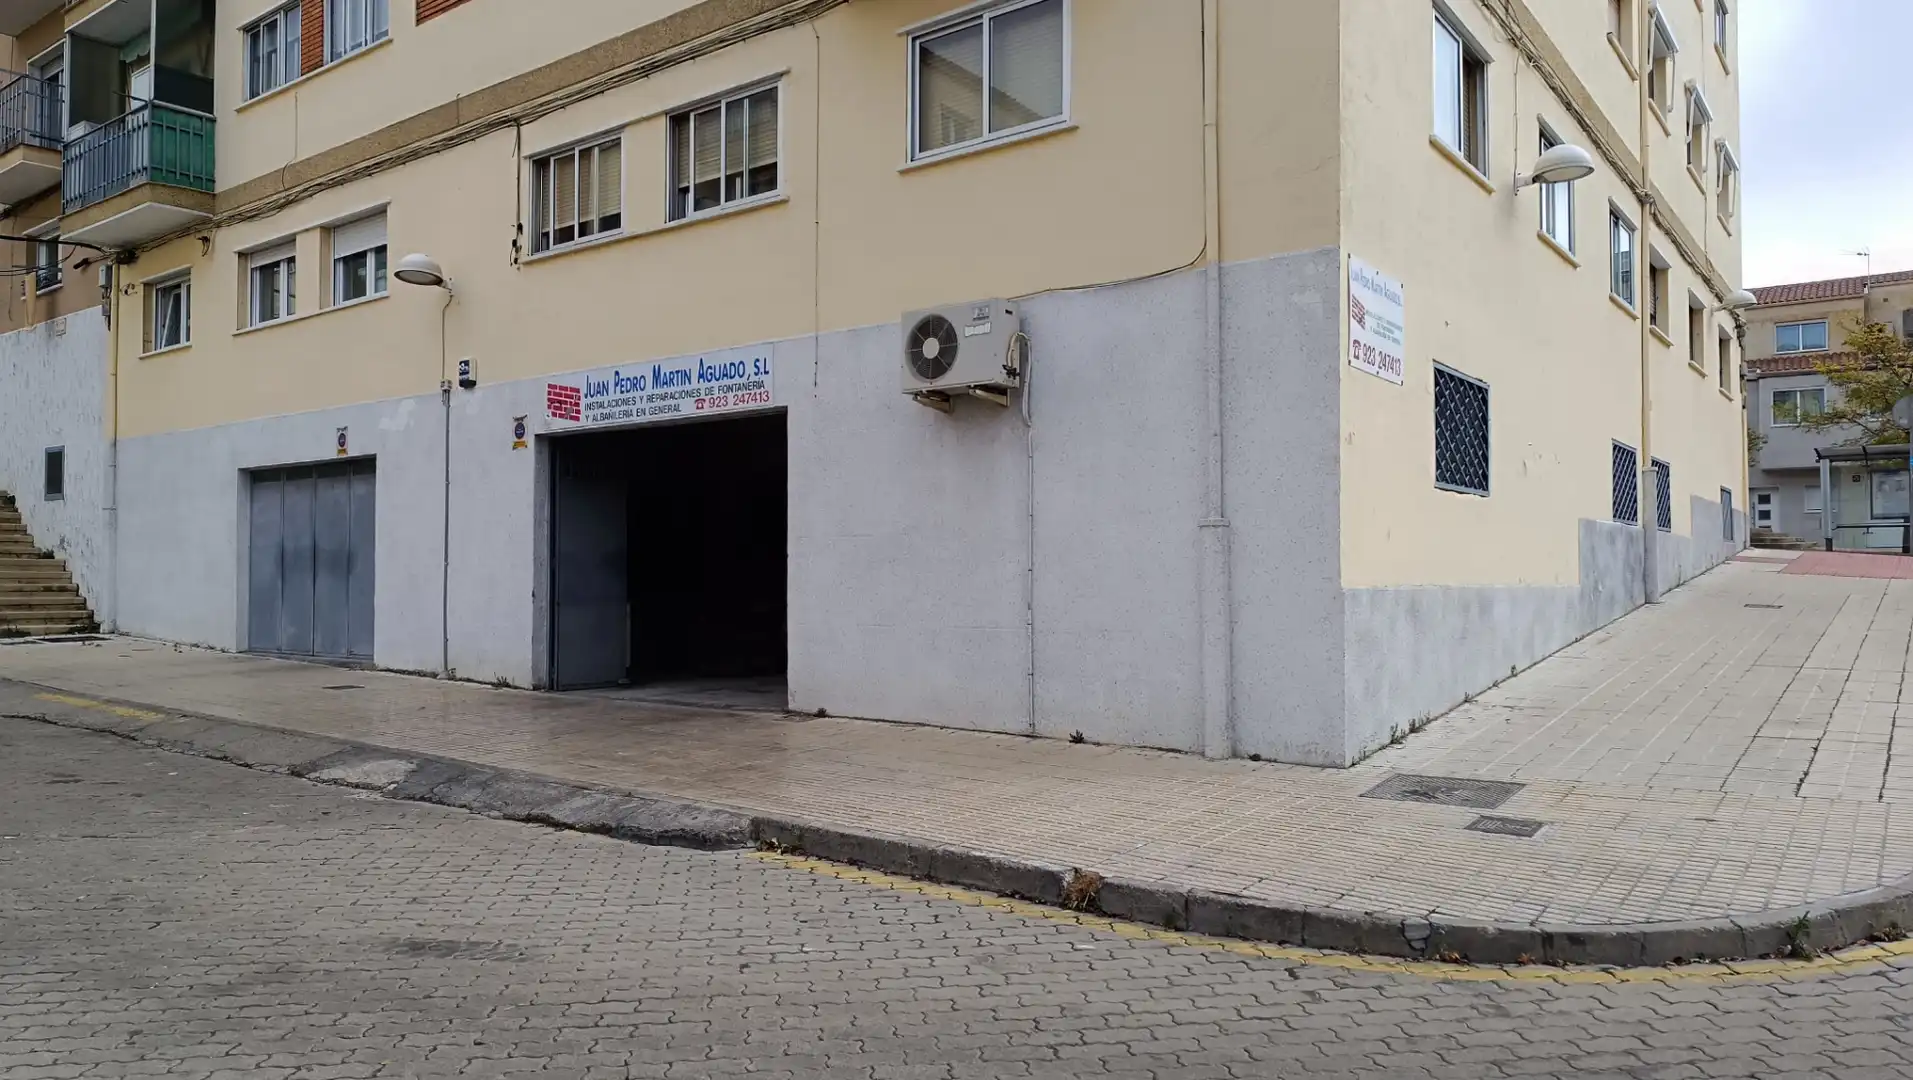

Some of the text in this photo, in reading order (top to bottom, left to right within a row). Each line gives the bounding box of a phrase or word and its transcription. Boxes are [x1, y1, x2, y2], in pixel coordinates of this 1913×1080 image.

[1363, 343, 1401, 376] 923 247413
[584, 375, 610, 399] JUAN
[614, 371, 646, 394] PEDRO
[652, 364, 692, 388] MARTIN
[698, 358, 751, 383] AGUADO,
[584, 396, 637, 412] INSTALACIONES
[639, 395, 645, 404] Y
[646, 388, 701, 405] REPARACIONES
[704, 386, 715, 396] DE
[708, 391, 770, 409] 923 247413
[585, 414, 590, 422] Y
[636, 408, 647, 417] EN
[649, 404, 682, 416] GENERAL
